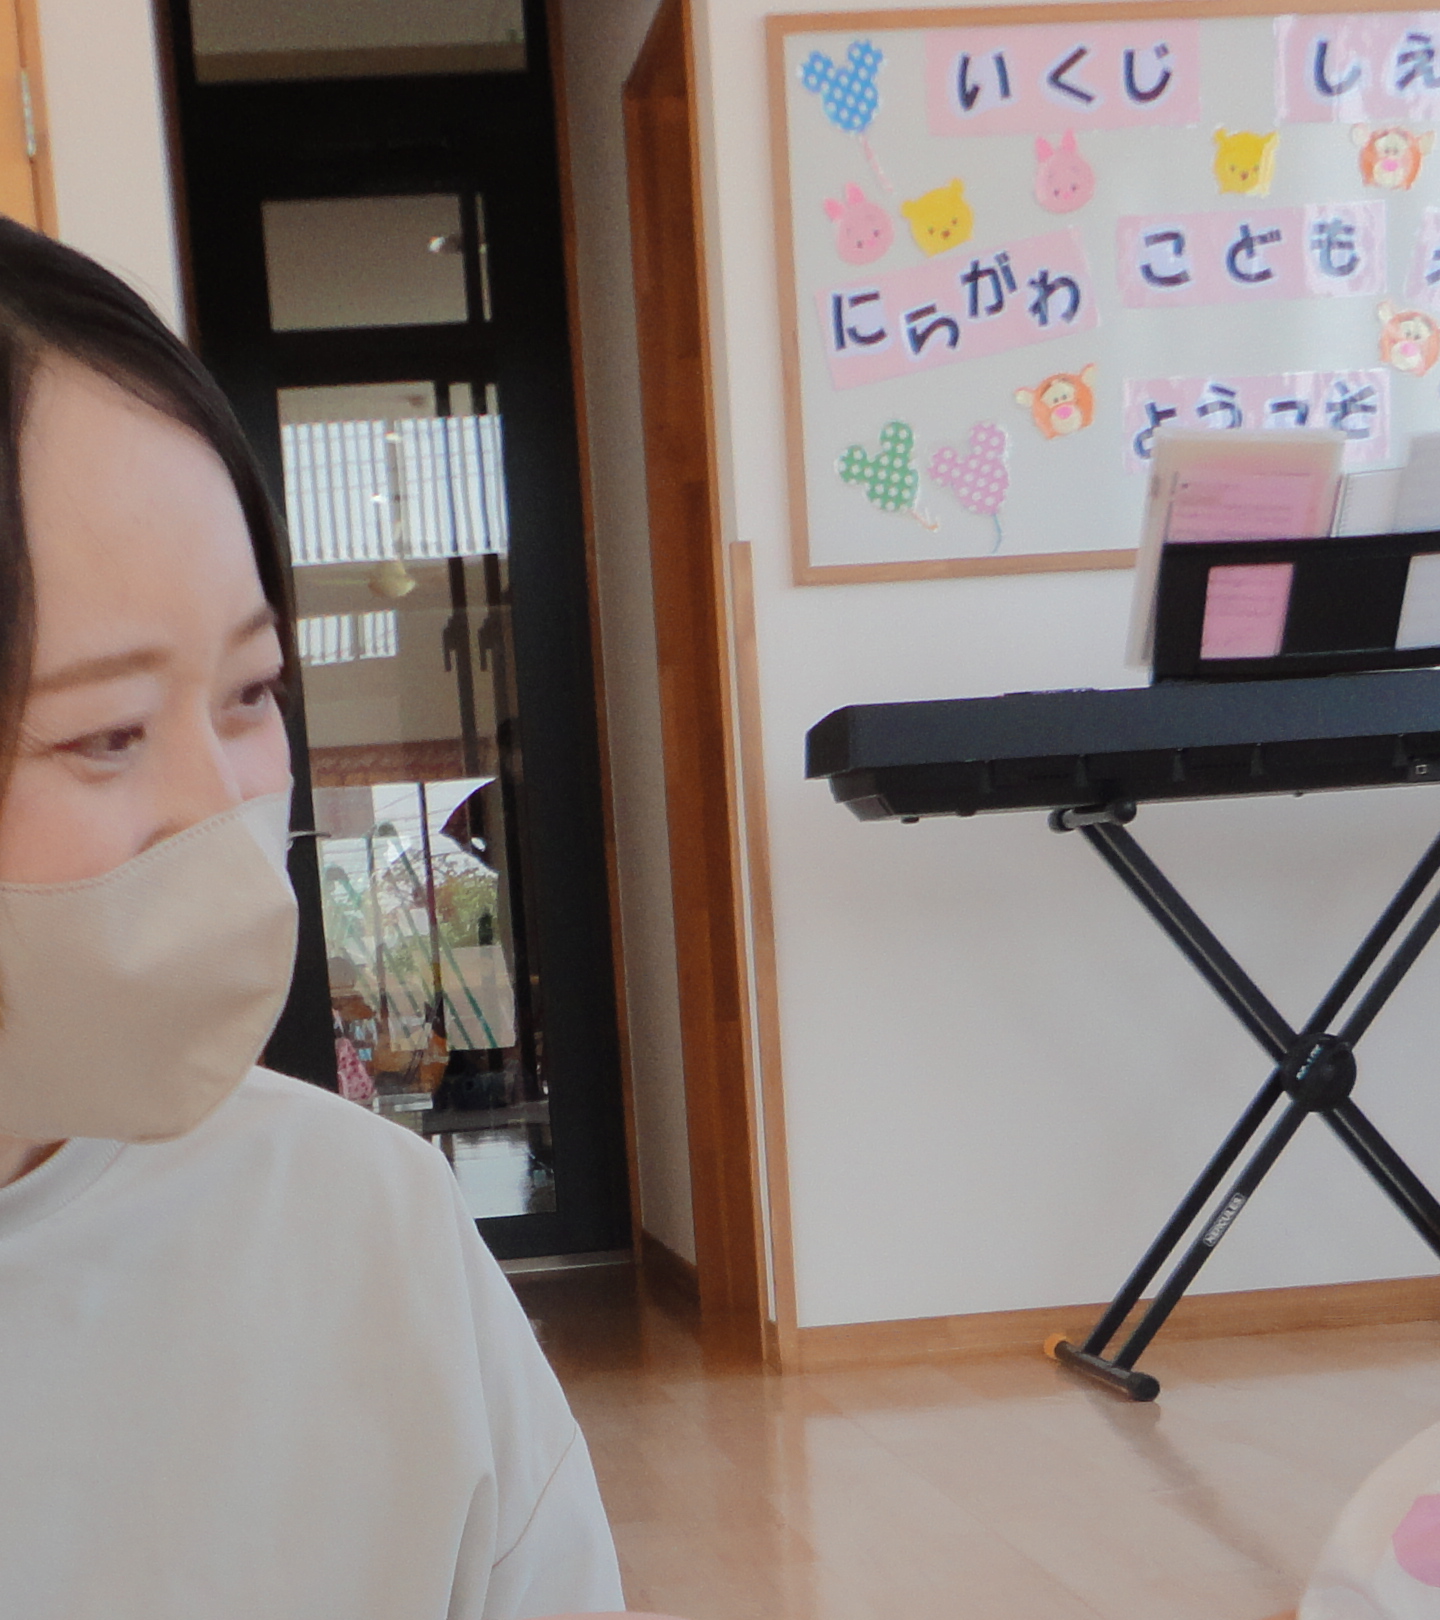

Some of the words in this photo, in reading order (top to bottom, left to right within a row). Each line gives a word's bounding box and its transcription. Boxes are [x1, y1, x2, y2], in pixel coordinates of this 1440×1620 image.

[956, 43, 1172, 112] いくじ
[831, 250, 1081, 355] にらがわ
[1140, 217, 1361, 287] こども
